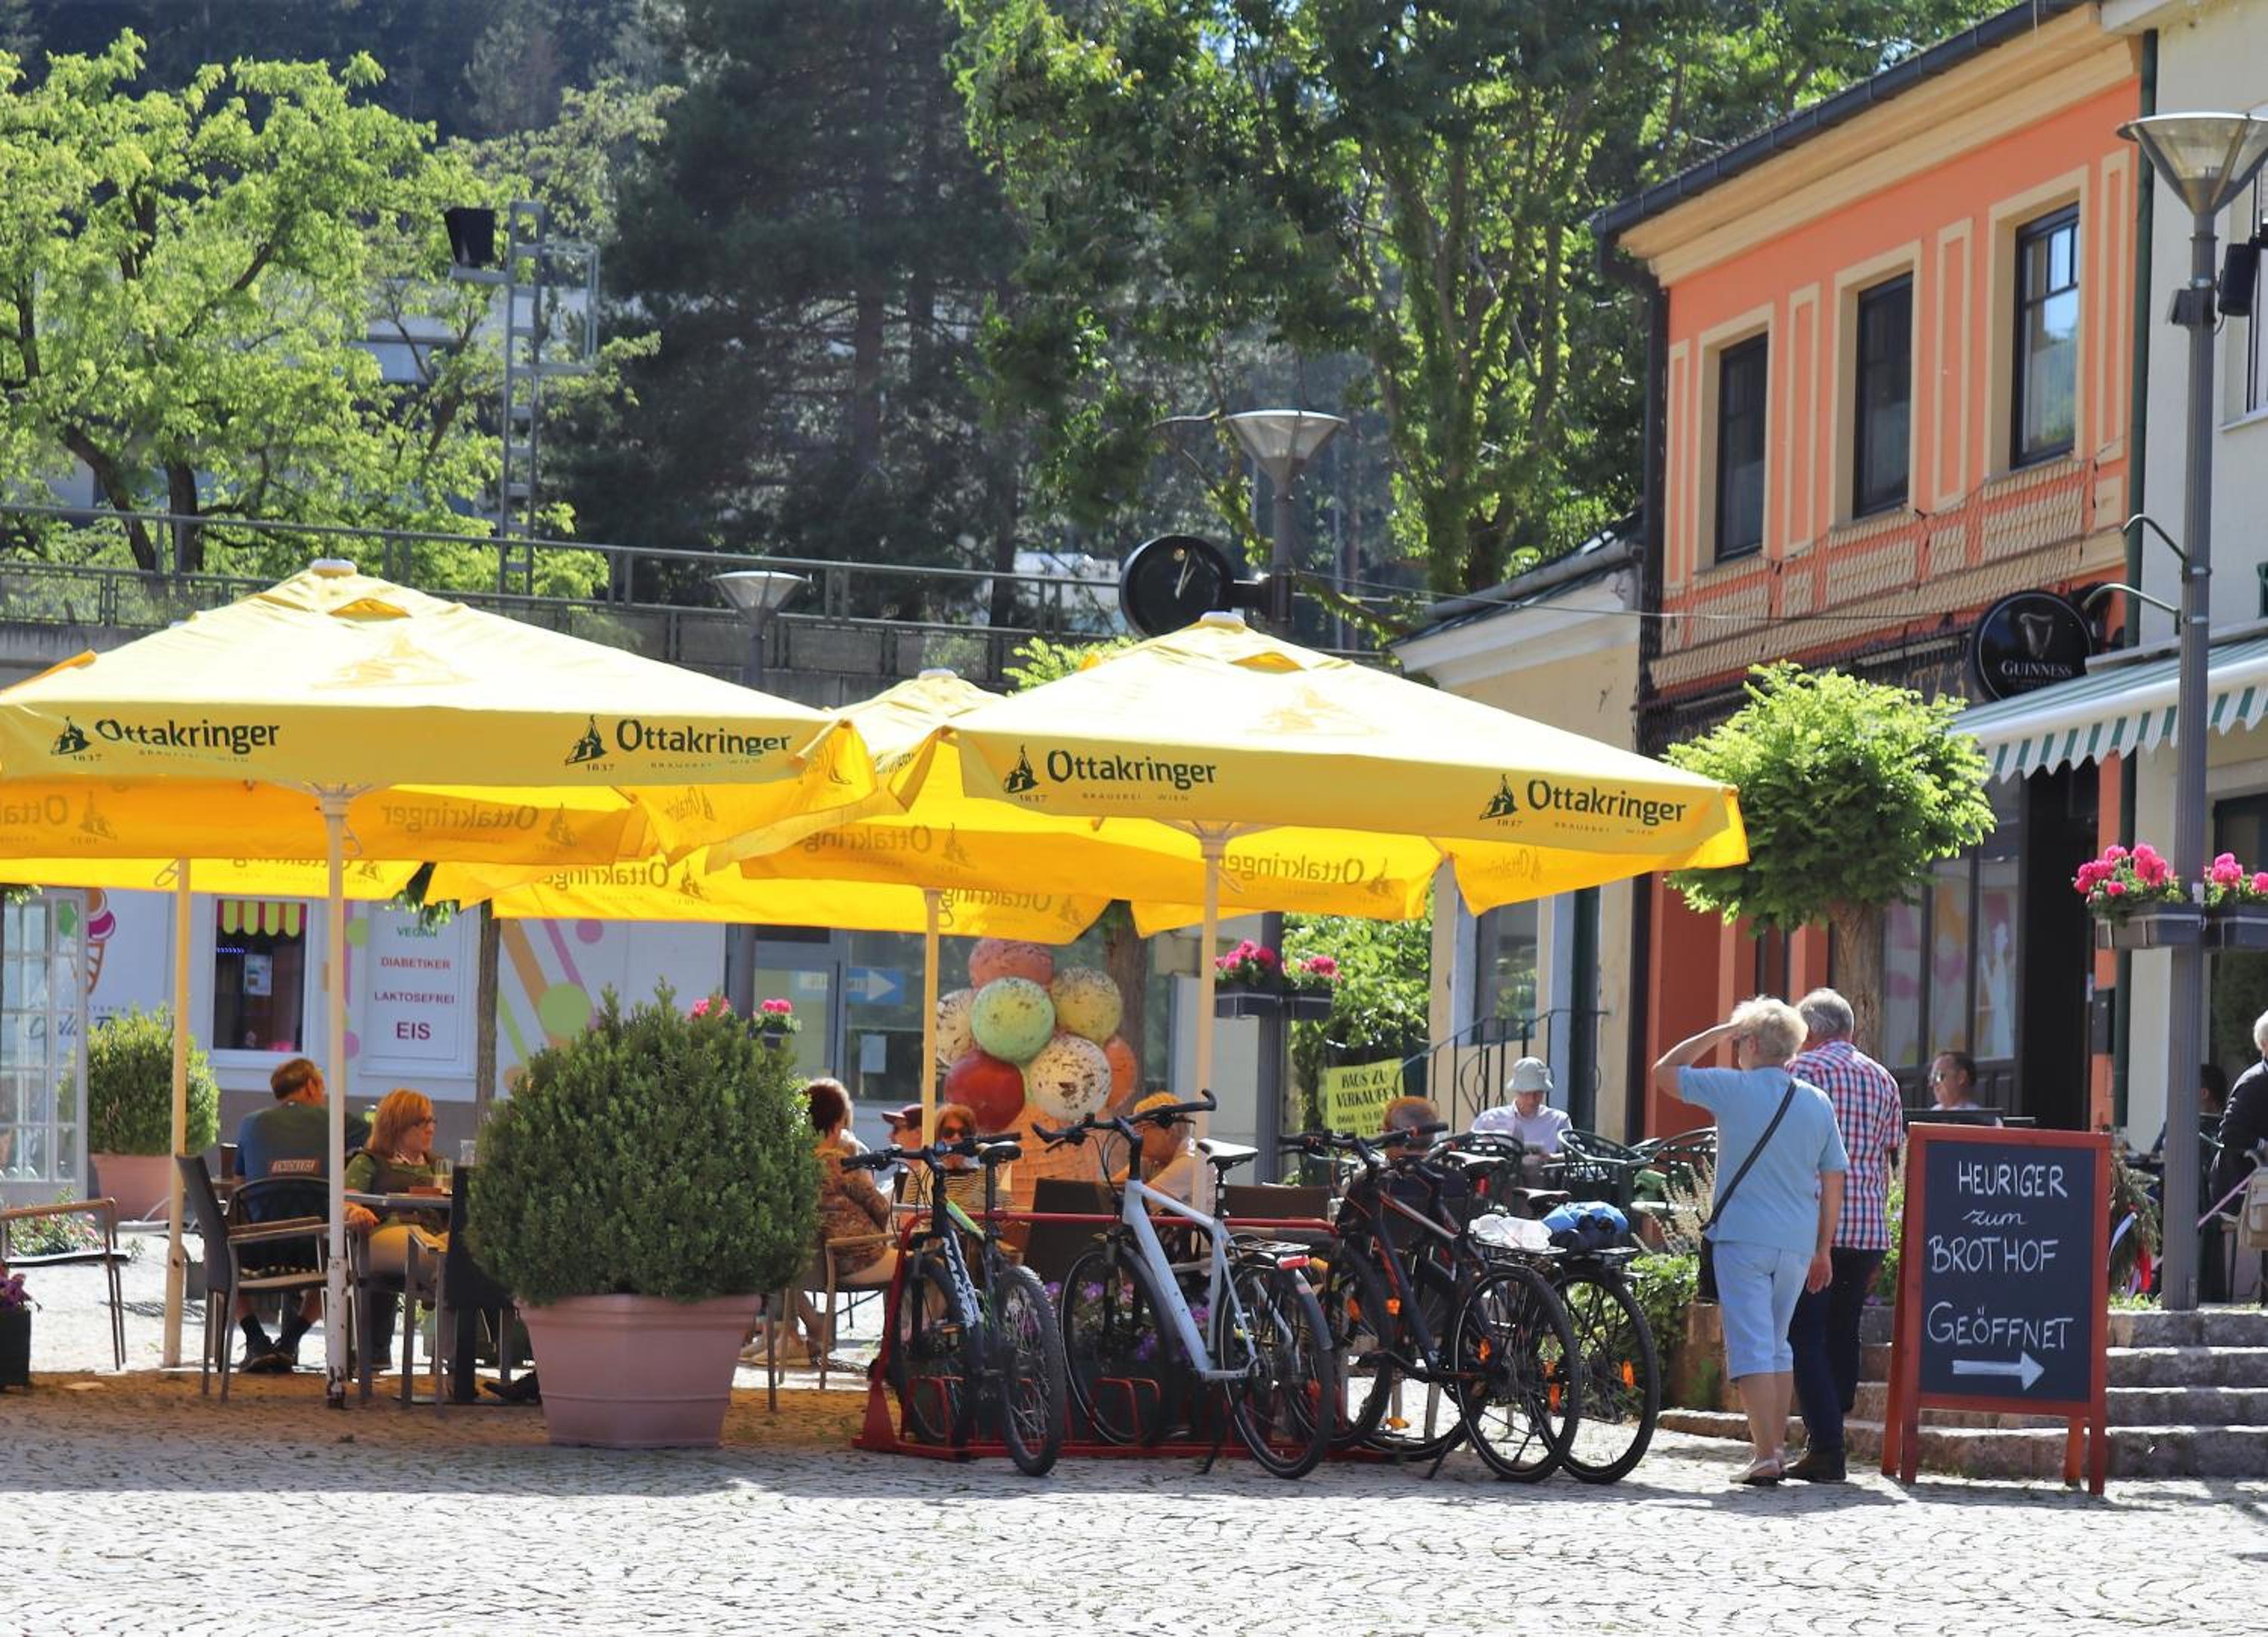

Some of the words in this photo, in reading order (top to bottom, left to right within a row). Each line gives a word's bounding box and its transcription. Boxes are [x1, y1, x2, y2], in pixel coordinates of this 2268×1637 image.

[2001, 660, 2072, 677] GUINNESS
[95, 719, 280, 754] Ottakringer
[616, 719, 792, 755] Ottakringer
[1047, 750, 1216, 790] Ottakringer
[1527, 779, 1686, 826] Ottakringer
[397, 927, 437, 938] VEGAN
[380, 958, 451, 970] DIABETIKER
[374, 991, 455, 1004] LAKTOSEFREI
[396, 1021, 431, 1040] EIS
[1958, 1160, 2068, 1198] HEURIGER
[1962, 1208, 2027, 1225] zum
[1929, 1235, 2059, 1274] BROTHOF
